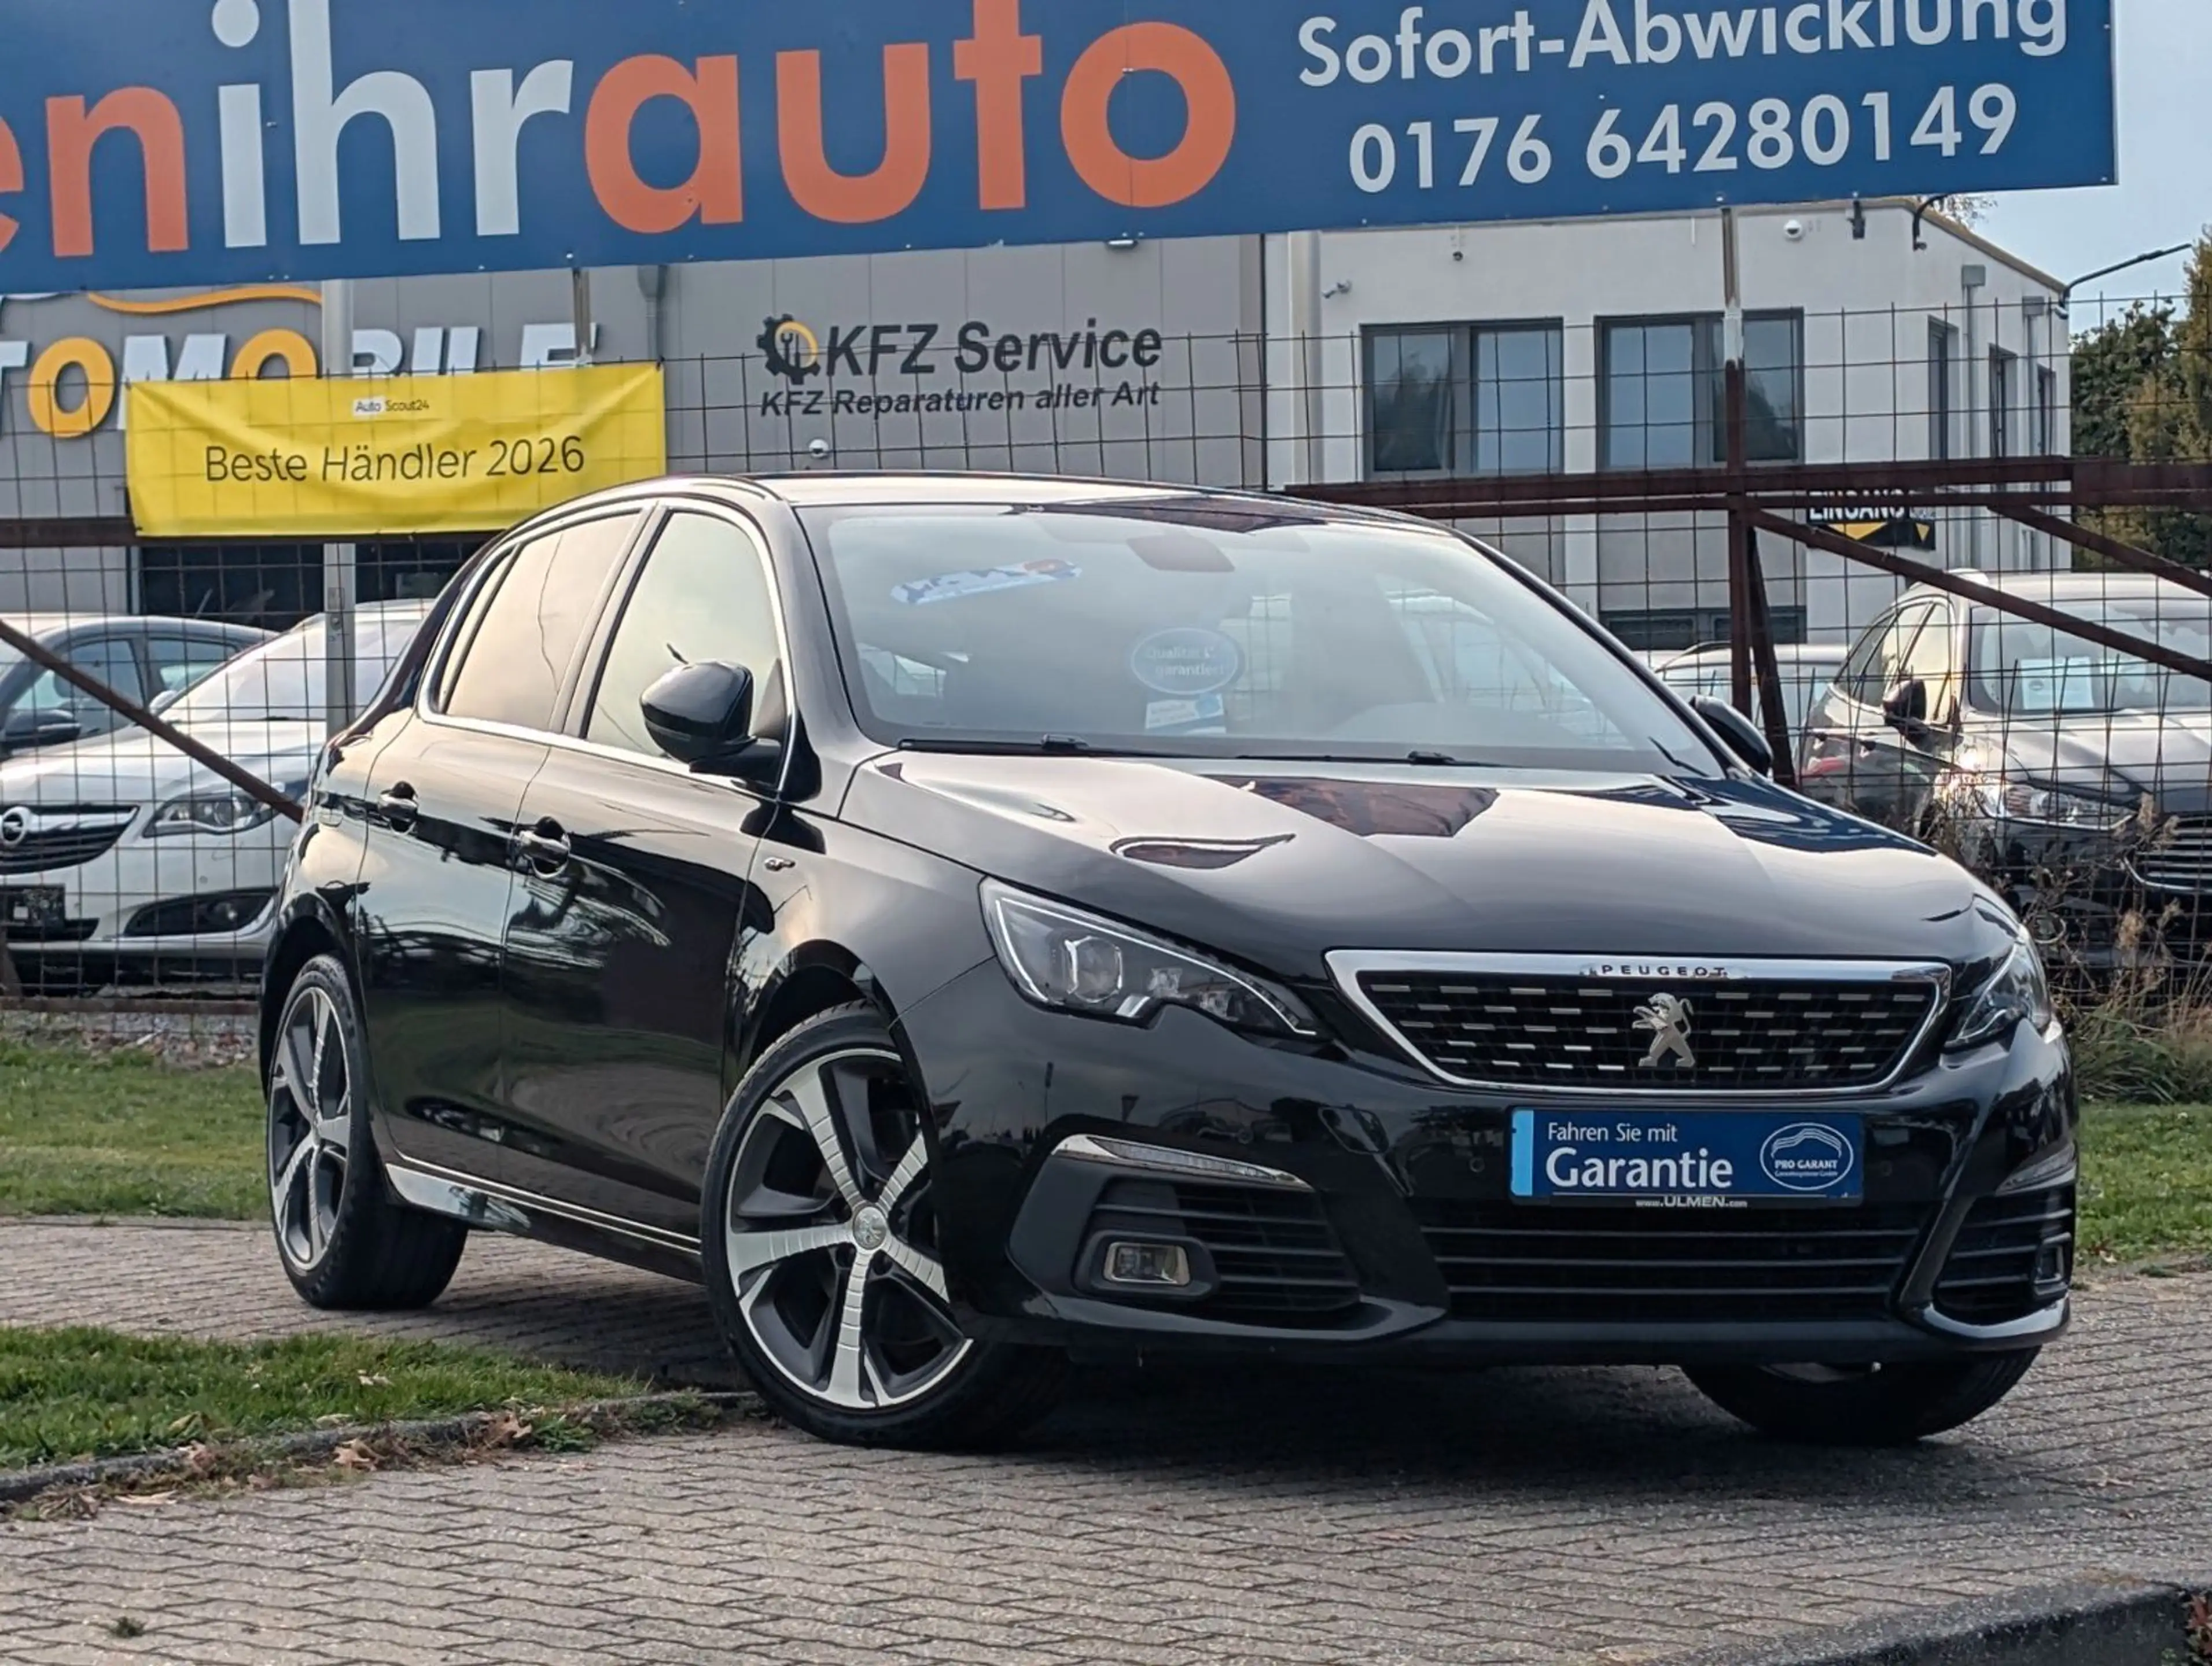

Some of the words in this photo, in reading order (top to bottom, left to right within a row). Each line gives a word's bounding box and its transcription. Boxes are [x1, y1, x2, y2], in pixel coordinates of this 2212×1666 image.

[1298, 0, 2067, 87] Sofort-Abwicklung
[0, 0, 1236, 257] nihrauto
[1349, 114, 1552, 193] 0176
[1586, 83, 2016, 179] 64280149
[827, 324, 938, 377] KFZ
[955, 318, 1162, 373] Service
[356, 400, 381, 412] Auto
[385, 399, 429, 412] Scout24
[761, 390, 825, 417] KFZ
[834, 387, 1024, 418] Reparaturen
[1036, 383, 1103, 410] aller
[1111, 381, 1160, 407] Art
[205, 445, 307, 482] Beste
[322, 442, 477, 482] Händler
[485, 436, 584, 476] 2026
[1601, 964, 1728, 976] PEUGEOT
[1548, 1122, 1609, 1142] Fahren
[1615, 1122, 1641, 1142] Sie
[1647, 1123, 1678, 1142] mit
[1546, 1147, 1733, 1188] Garantie
[1774, 1159, 1794, 1169] PRO
[1797, 1159, 1839, 1169] GARANT
